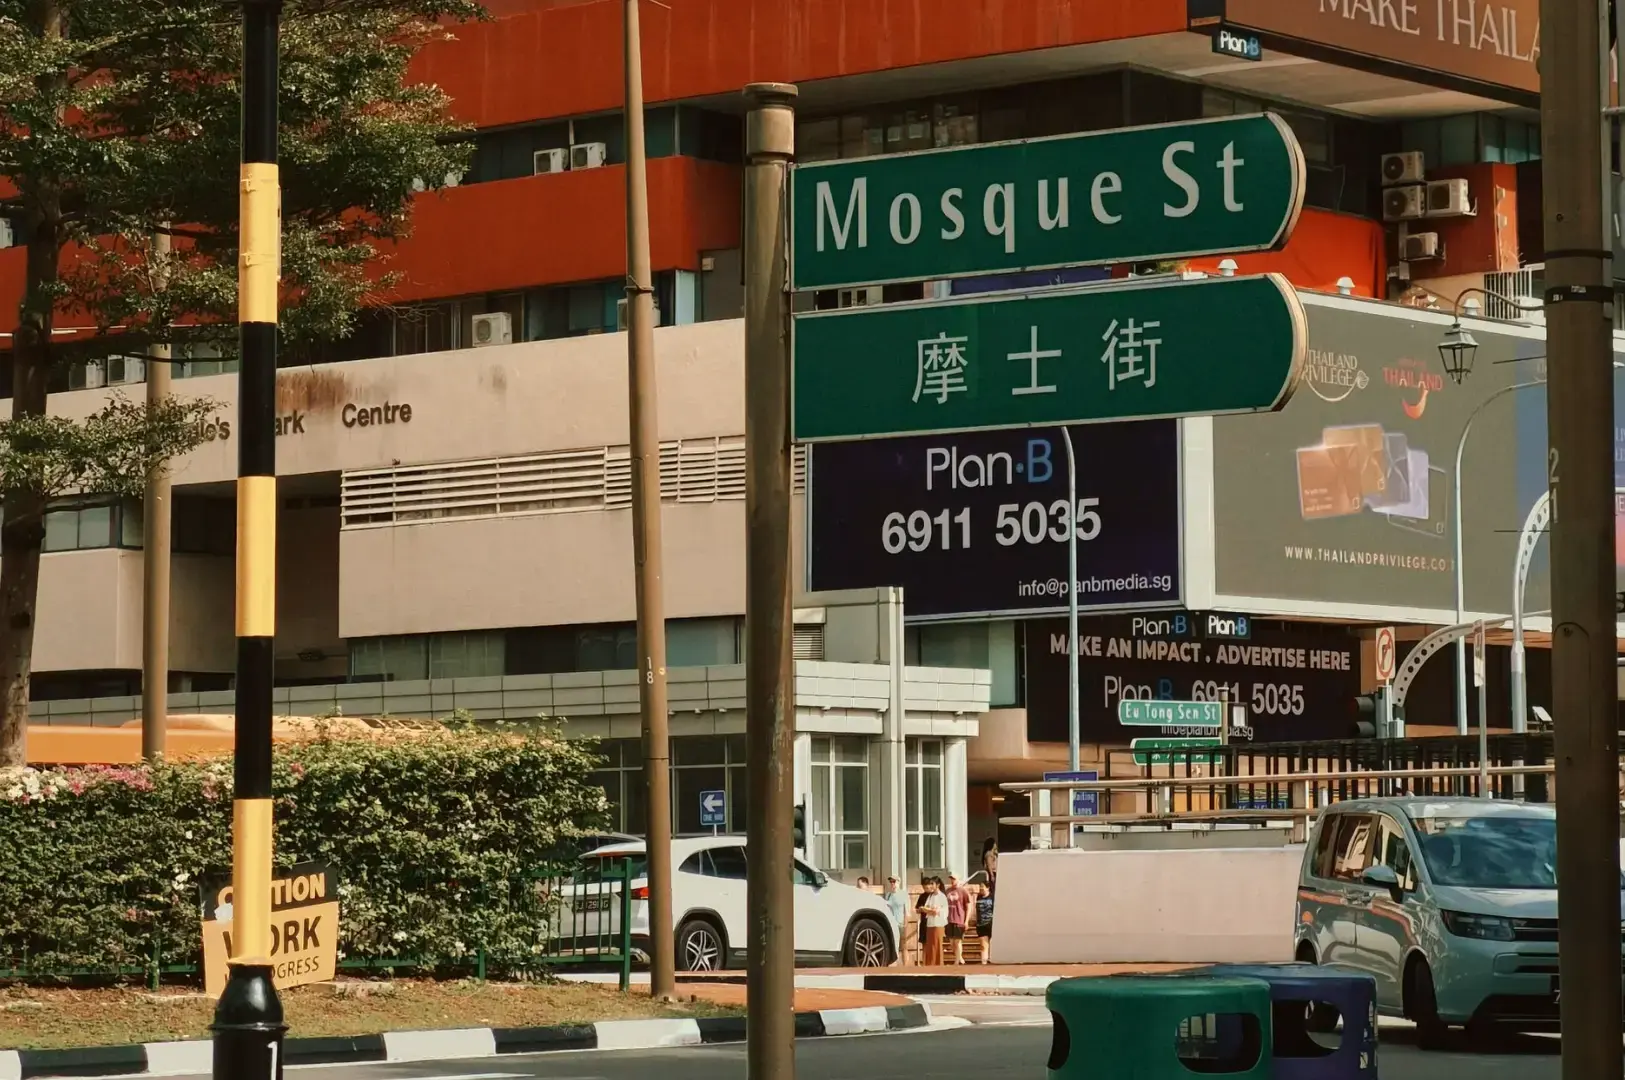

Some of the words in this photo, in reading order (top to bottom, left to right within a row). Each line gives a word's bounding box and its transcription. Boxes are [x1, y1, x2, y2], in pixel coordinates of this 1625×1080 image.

[816, 171, 1122, 253] Mosque
[1162, 140, 1244, 218] St
[911, 317, 1162, 404] 摩士街
[1301, 364, 1355, 387] RIVILEGE
[1308, 349, 1357, 370] THAILAND
[275, 410, 305, 436] ark
[341, 400, 412, 428] Centre
[881, 507, 971, 554] 6911
[995, 498, 1101, 546] 5035
[1018, 574, 1172, 597] info@panbmedia.sg
[1106, 637, 1131, 658] AN
[1136, 639, 1201, 663] IMPACT
[1216, 644, 1306, 668] ADVERTISE
[1310, 650, 1351, 671] HERE
[1125, 702, 1139, 719] Eu
[1145, 703, 1173, 723] Tong
[1179, 704, 1199, 720] Sen
[1204, 704, 1216, 721] St
[1191, 680, 1240, 704] 691
[1252, 682, 1304, 715] 5035
[218, 872, 325, 907] CTION
[222, 916, 322, 960] RK
[271, 955, 320, 979] GRESS
